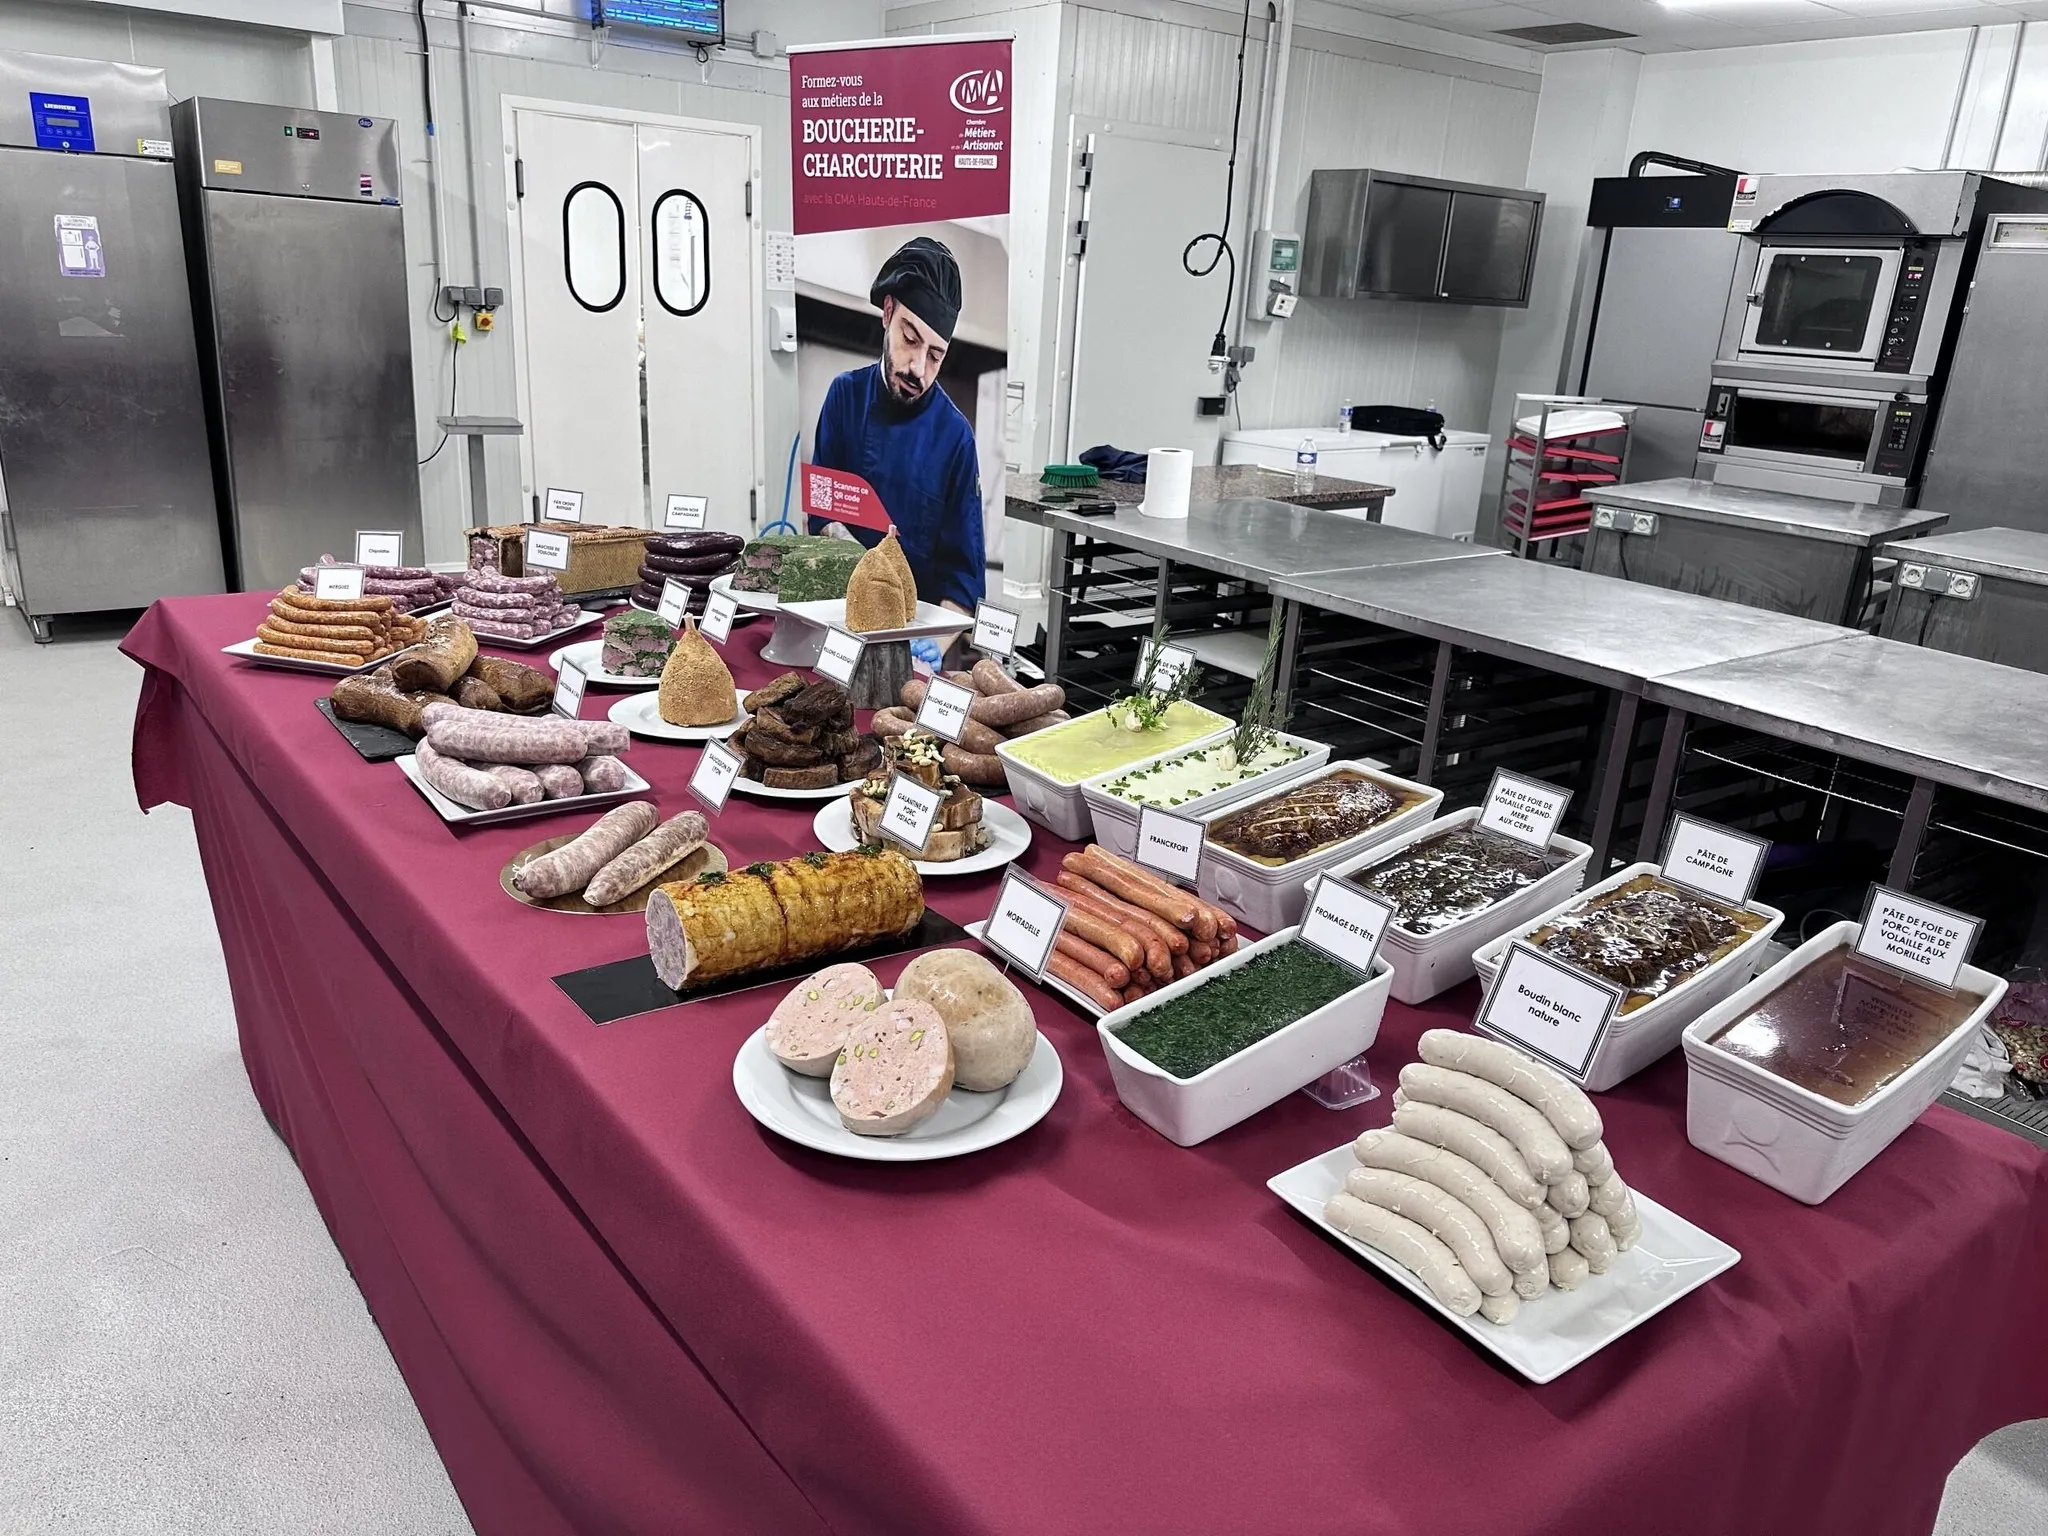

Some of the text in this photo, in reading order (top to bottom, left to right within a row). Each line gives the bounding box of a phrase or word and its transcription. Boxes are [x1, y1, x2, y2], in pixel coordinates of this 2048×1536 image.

[802, 75, 863, 89] Formez-vous
[802, 92, 883, 108] aux métiers de la
[802, 117, 925, 143] BOUCHERIE-
[964, 127, 997, 138] Métiers
[803, 154, 943, 179] CHARCUTERIE
[958, 157, 994, 166] HAUTS-DE-FRANCE
[804, 193, 937, 208] avec la CMA Hauts-de-France
[833, 481, 869, 495] Scannez ce
[833, 491, 860, 503] QR code
[979, 619, 1000, 630] SAUCISSON
[943, 701, 952, 709] AUX
[709, 753, 727, 770] SAUCISSON
[898, 792, 929, 813] GALANTINE DE
[902, 805, 916, 817] PORC
[1495, 794, 1552, 819] VOLAILLE GRAND-
[1517, 793, 1527, 802] DE
[1527, 797, 1543, 807] FOIE
[1543, 802, 1553, 811] DE
[896, 812, 917, 828] PISTACHE
[1498, 815, 1535, 833] AUX CEPES
[1149, 834, 1189, 854] FRANCKFORT
[1696, 848, 1729, 866] PÂTE DE
[1685, 855, 1735, 878] CAMPAGNE
[1006, 909, 1041, 938] MORTADELLE
[1315, 906, 1375, 942] FROMAGE DE TÊTE
[1882, 907, 1959, 940] PÂTE DE FOIE DE
[1882, 918, 1952, 949] PORC, FOIE DE
[1880, 929, 1947, 959] VOLAILLE AUX
[1886, 943, 1932, 966] MORILLES
[1517, 983, 1582, 1024] Boudin blanc
[1527, 1005, 1561, 1027] nature
